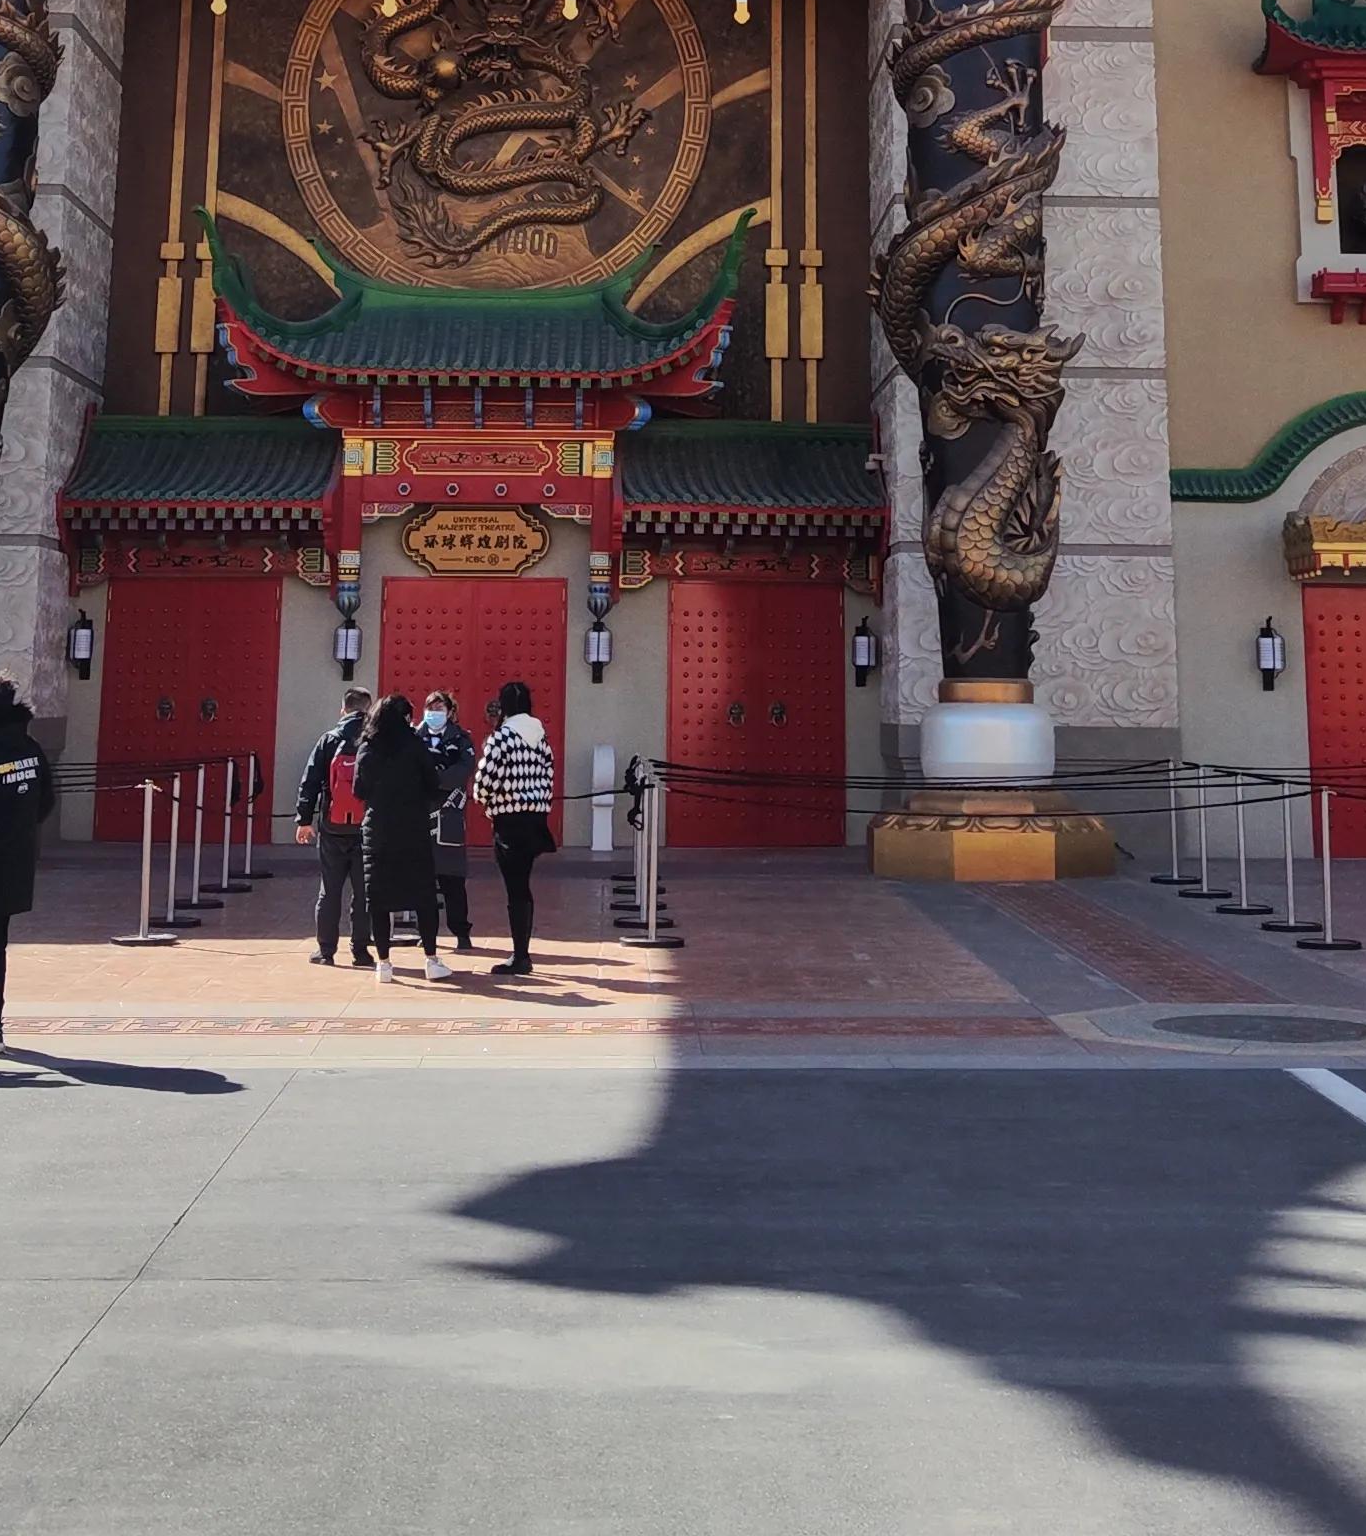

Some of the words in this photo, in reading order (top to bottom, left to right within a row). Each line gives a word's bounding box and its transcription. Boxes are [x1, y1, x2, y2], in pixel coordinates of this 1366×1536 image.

[486, 227, 558, 259] WOOD
[452, 516, 499, 524] UNIVERSAL
[437, 524, 476, 532] MAJESTIC
[424, 533, 528, 550] 环球辉煌剧院
